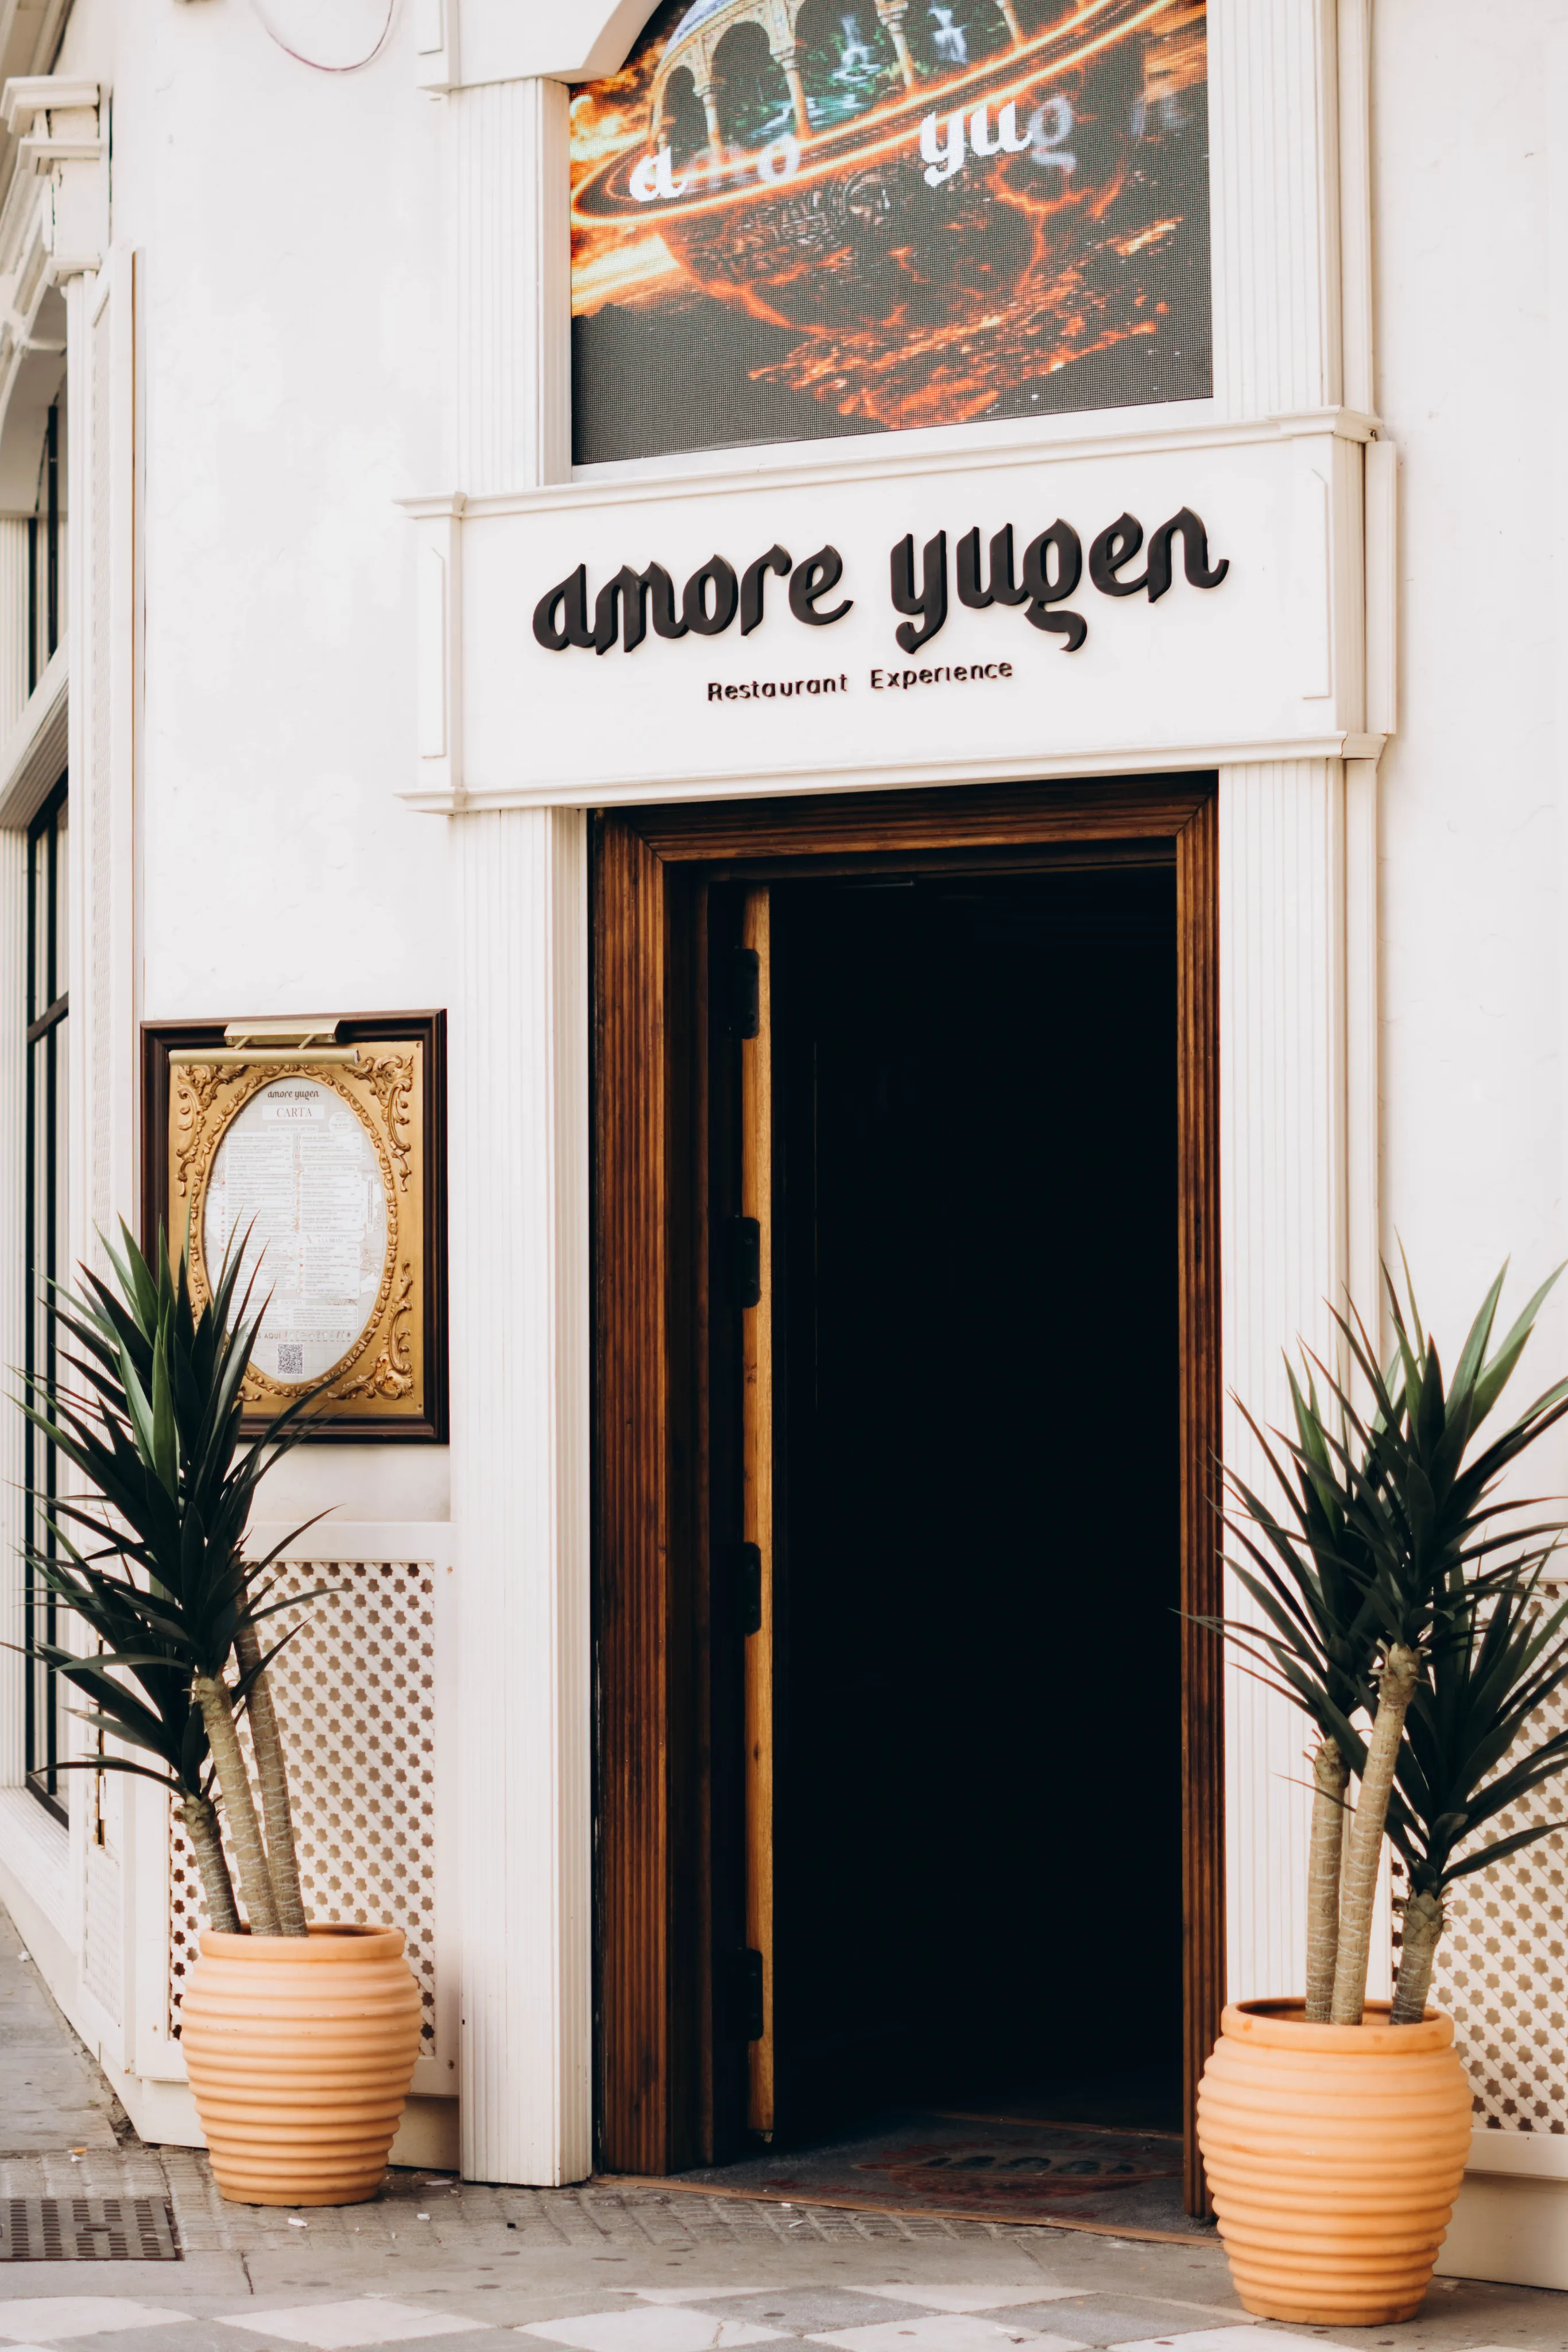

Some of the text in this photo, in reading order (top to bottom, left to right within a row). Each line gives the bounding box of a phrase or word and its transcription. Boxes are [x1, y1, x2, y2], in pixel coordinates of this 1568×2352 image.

[533, 508, 1229, 655] amore yugen
[708, 662, 1013, 701] Restaurant Experience
[295, 1090, 319, 1100] yugen
[276, 1107, 312, 1118] CARTA
[264, 1331, 281, 1339] AQUÍ
